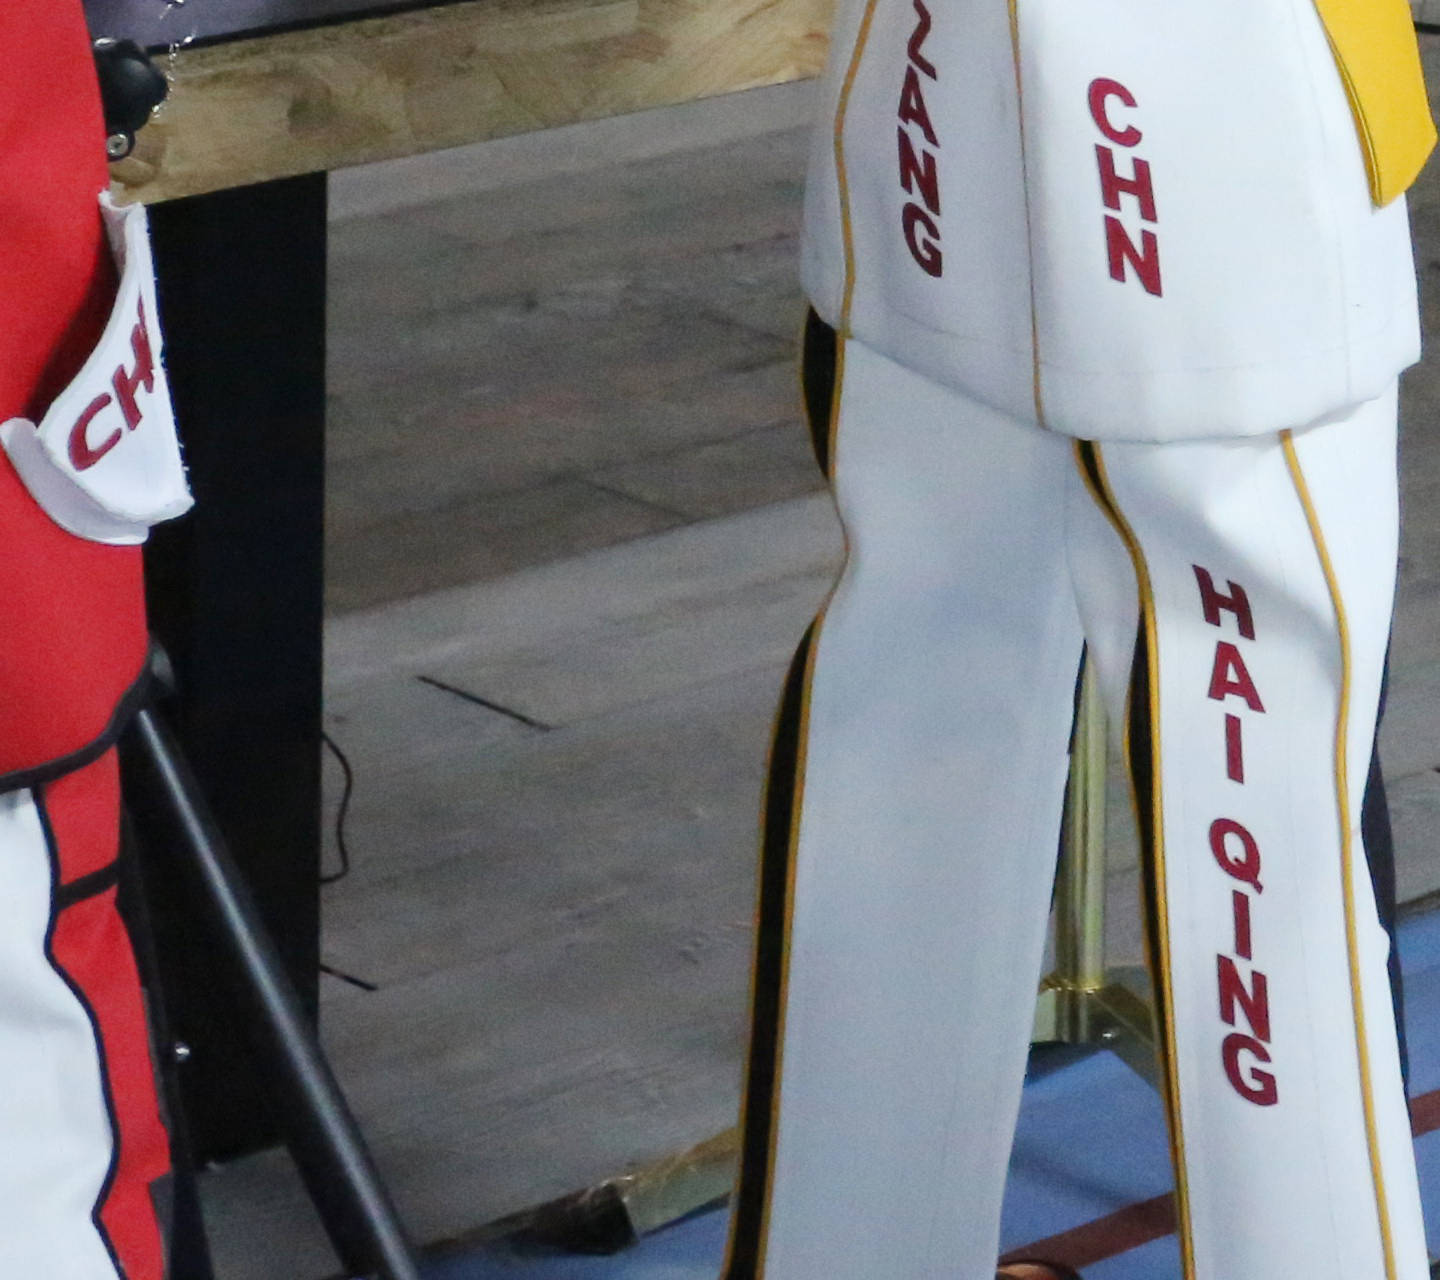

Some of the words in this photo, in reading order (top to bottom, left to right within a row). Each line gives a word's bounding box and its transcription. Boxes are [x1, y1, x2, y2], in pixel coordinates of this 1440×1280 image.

[1087, 77, 1163, 298] CHN
[1191, 563, 1266, 785] HAI
[1208, 817, 1279, 1106] QING
